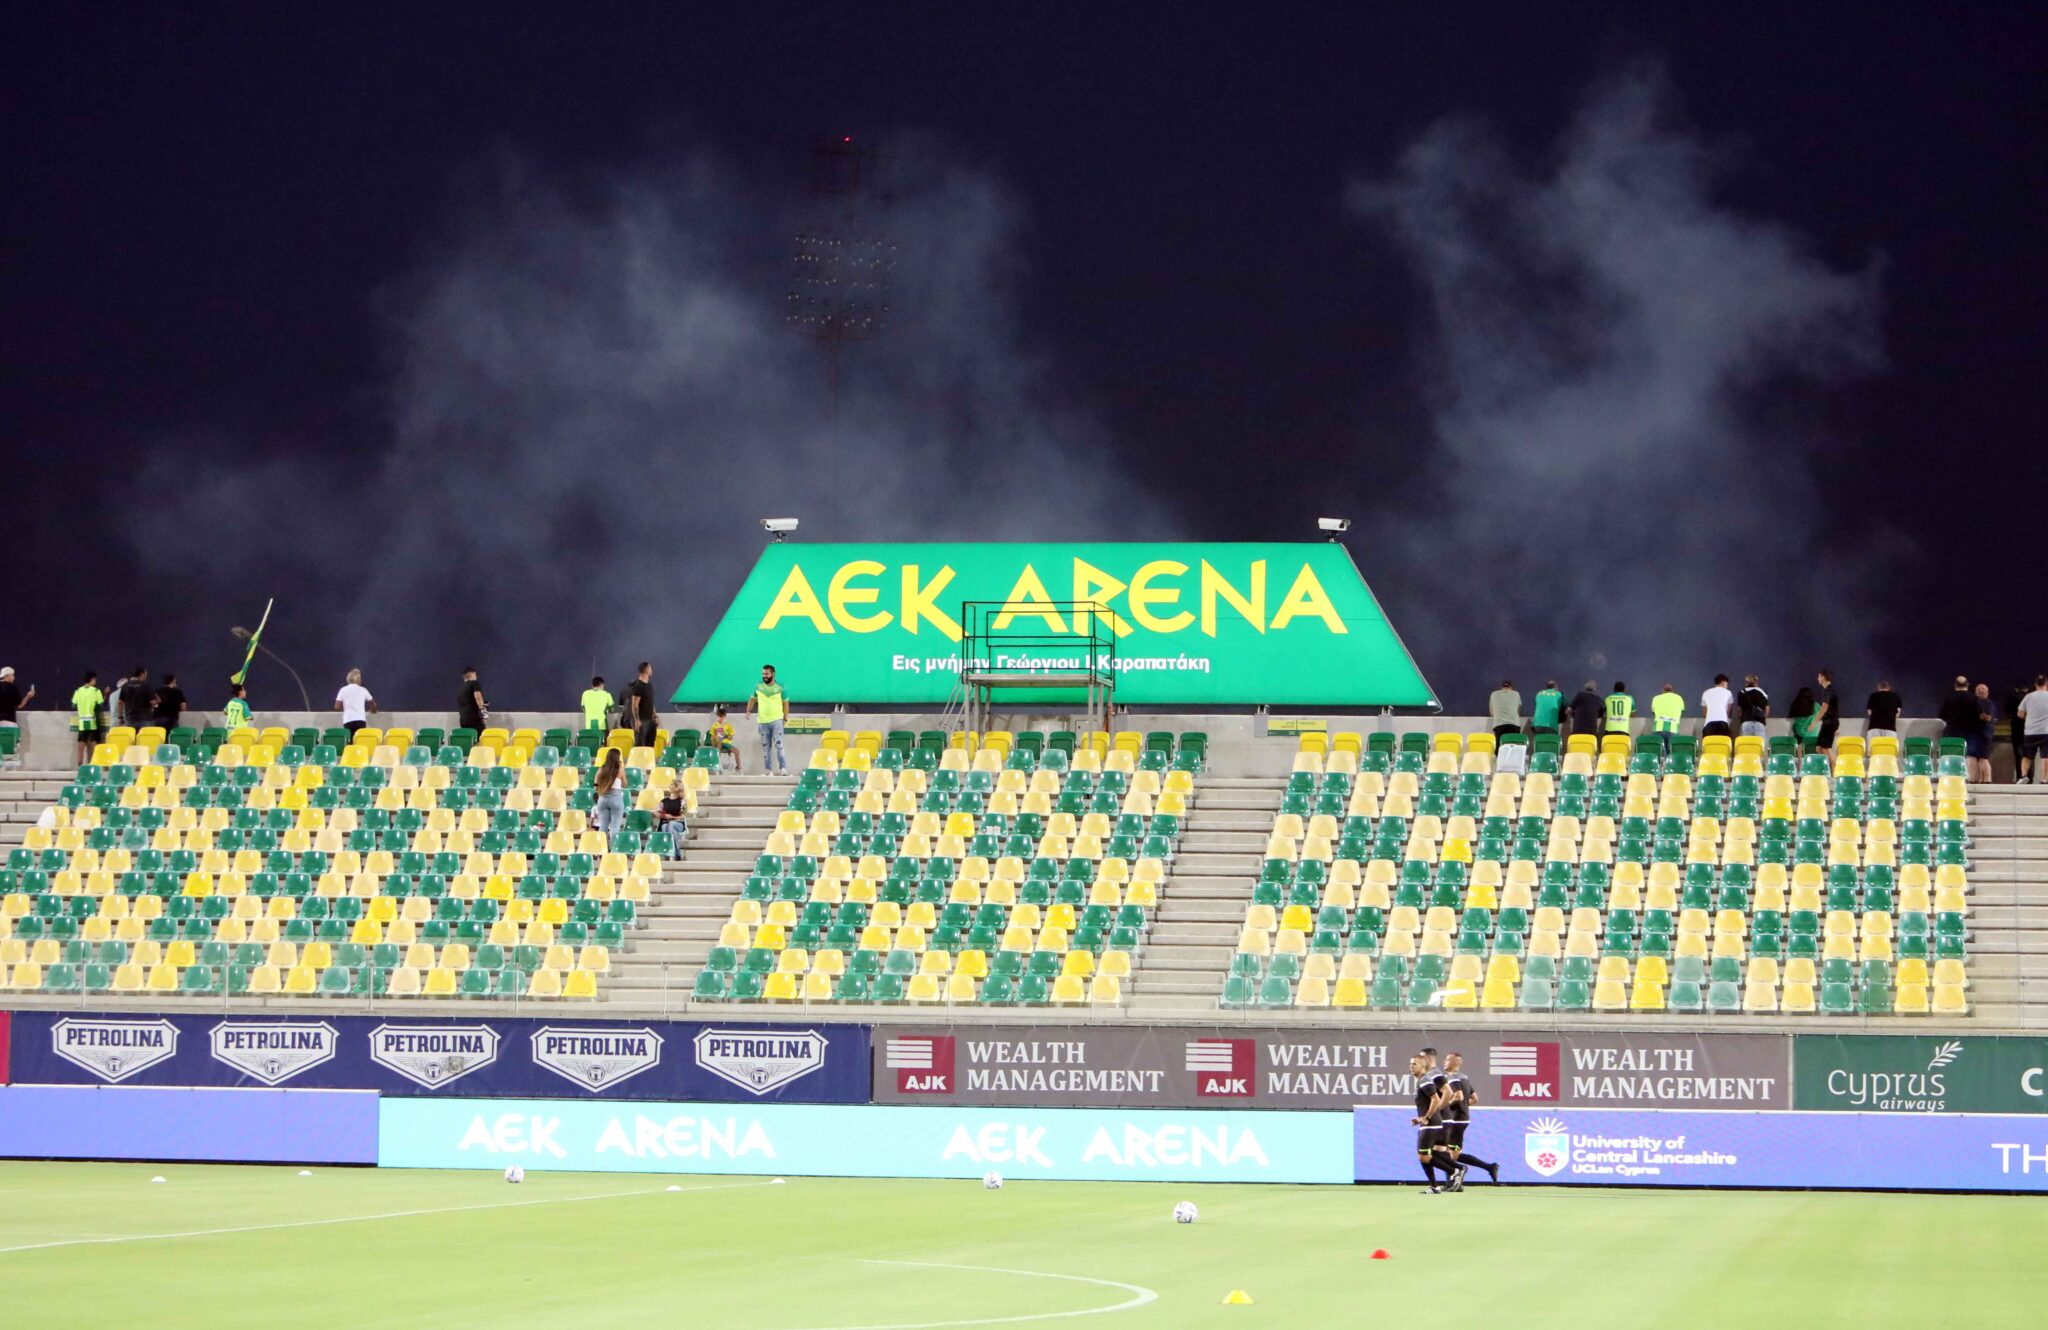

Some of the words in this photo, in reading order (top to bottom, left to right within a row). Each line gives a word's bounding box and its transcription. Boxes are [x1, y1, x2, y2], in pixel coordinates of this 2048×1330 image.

[759, 560, 969, 642] AEK
[992, 557, 1348, 638] ARENA
[892, 654, 920, 671] Εις
[997, 653, 1079, 674] Γεώργιου
[1611, 700, 1624, 716] 10
[66, 1028, 164, 1048] PETROLINA
[224, 1032, 323, 1050] PETROLINA
[384, 1034, 485, 1053] PETROLINA
[546, 1036, 648, 1056] PETROLINA
[708, 1039, 812, 1058] PETROLINA
[967, 1041, 1086, 1064] WEALTH
[1267, 1044, 1388, 1067] WEALTH
[1572, 1048, 1694, 1071] WEALTH
[905, 1075, 947, 1090] AJK
[966, 1069, 1164, 1092] MANAGEMENT
[1205, 1079, 1247, 1094] AJK
[1267, 1072, 1418, 1096] MANAGEM
[1509, 1082, 1552, 1097] AJK
[1572, 1077, 1775, 1100] MANAGEMENT
[1880, 1097, 1945, 1113] airways
[458, 1113, 568, 1159] AEK
[594, 1113, 777, 1159] ARENA
[943, 1122, 1055, 1168] AEK
[1081, 1121, 1270, 1167] ARENA
[1572, 1135, 1661, 1151] University
[1665, 1136, 1686, 1149] of
[1572, 1149, 1637, 1163] Central
[1643, 1150, 1738, 1166] Lancashire
[1615, 1164, 1661, 1177] Cyprus
